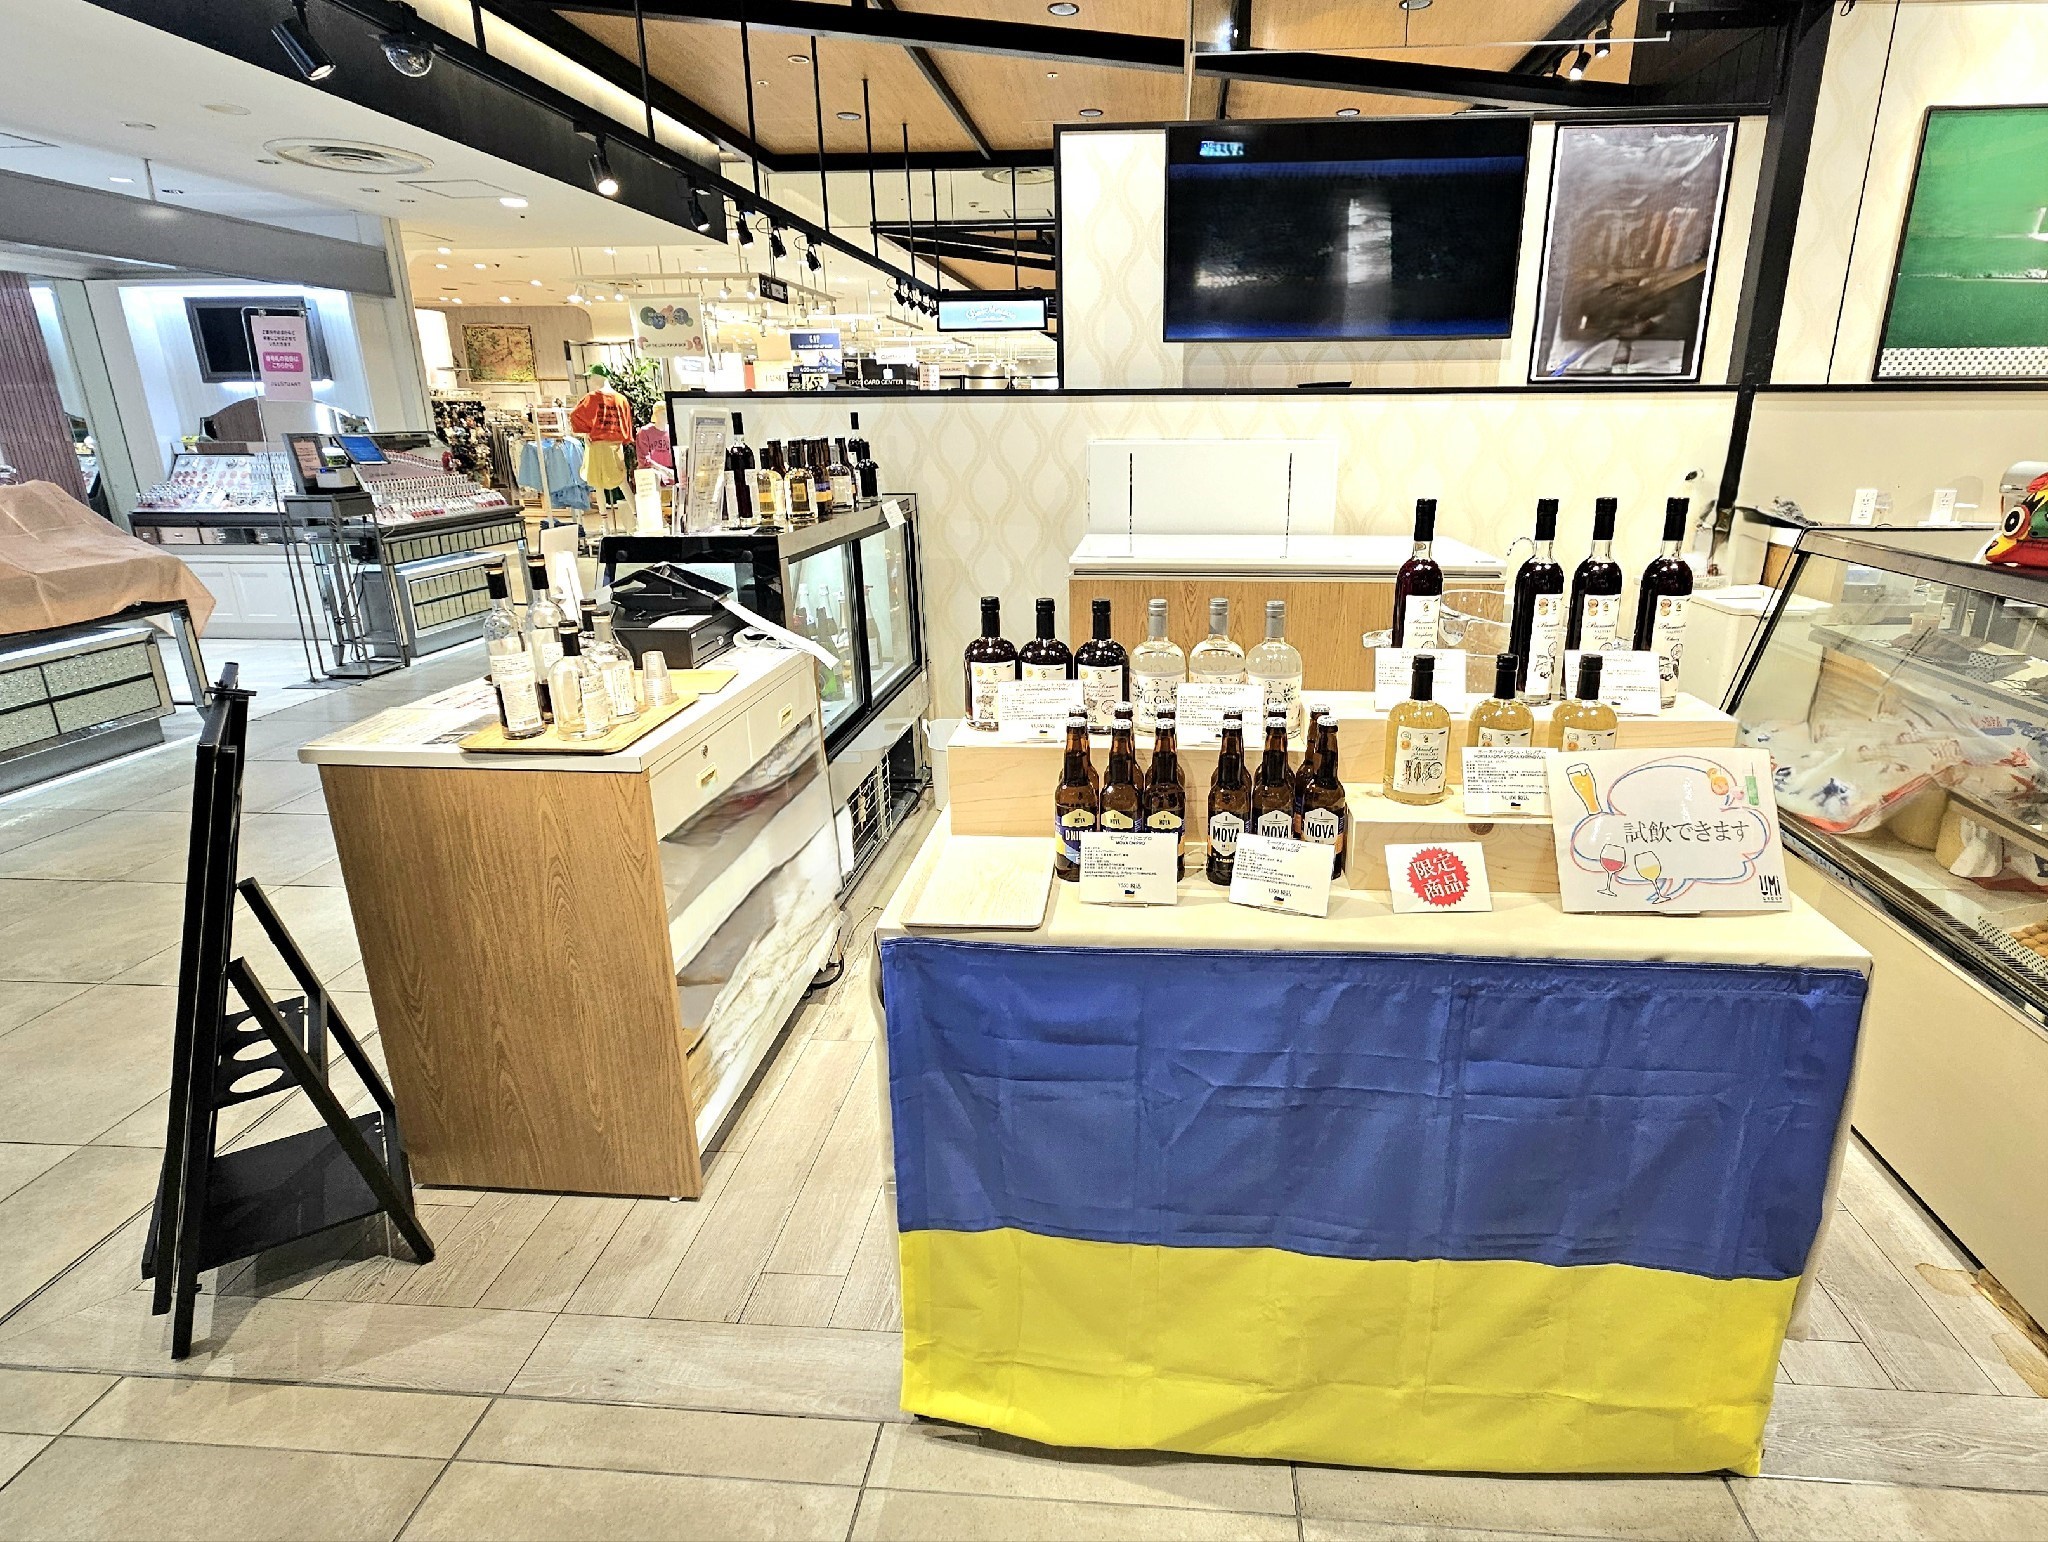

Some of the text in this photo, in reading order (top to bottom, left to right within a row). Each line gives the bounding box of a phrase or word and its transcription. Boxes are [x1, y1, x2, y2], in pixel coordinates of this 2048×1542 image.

[1212, 825, 1240, 843] MOVA
[1261, 824, 1289, 839] MOVA
[1306, 821, 1335, 839] MOVA
[1623, 820, 1750, 844] 試飲できます
[1411, 853, 1457, 881] 限定
[1421, 872, 1465, 901] 商品
